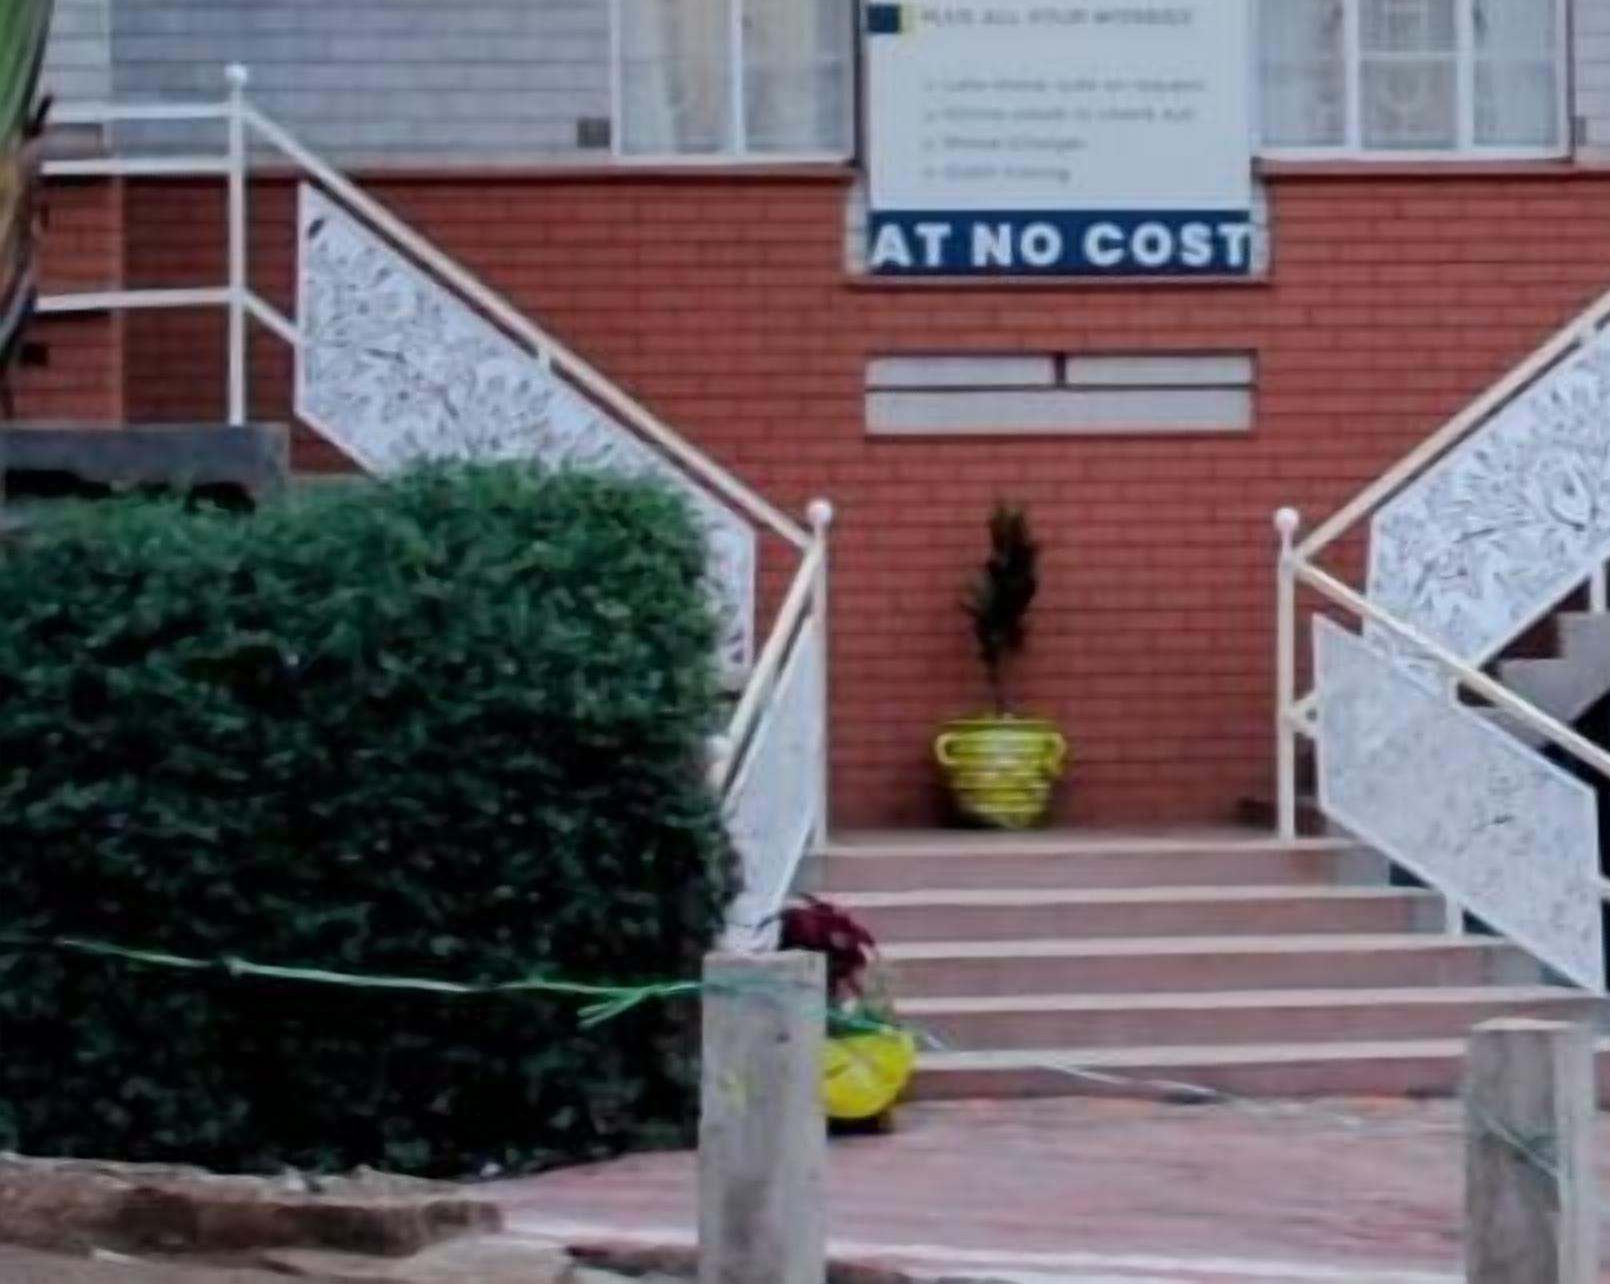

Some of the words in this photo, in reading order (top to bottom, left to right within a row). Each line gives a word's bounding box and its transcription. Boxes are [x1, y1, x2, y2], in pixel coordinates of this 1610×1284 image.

[870, 222, 952, 267] AT
[971, 222, 1063, 267] NO
[1083, 222, 1252, 268] COST
